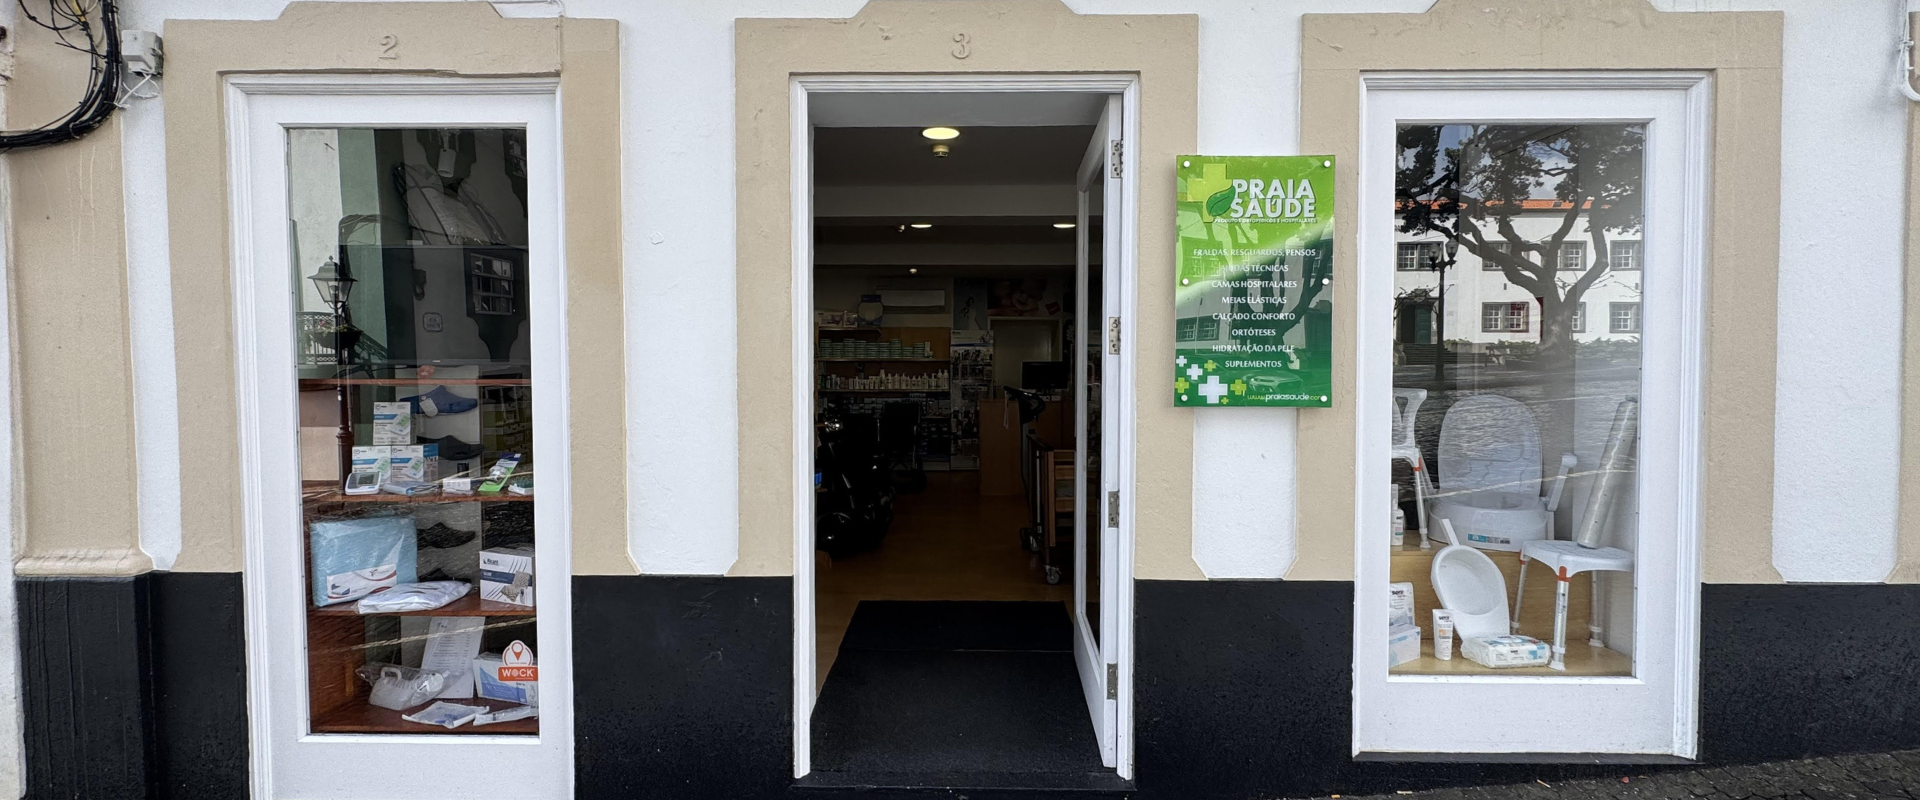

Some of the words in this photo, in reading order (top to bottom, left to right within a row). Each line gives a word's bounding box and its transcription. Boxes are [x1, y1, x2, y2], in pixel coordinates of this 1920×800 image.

[379, 33, 399, 60] 2
[951, 32, 971, 60] 3
[1232, 178, 1316, 200] PRAIA
[1230, 198, 1317, 218] SAÚDE
[1193, 248, 1229, 257] FRALDAS,
[1230, 248, 1285, 257] RESGUARDOS,
[1286, 248, 1316, 256] PENSOS
[1211, 280, 1240, 288] CAMAS
[1240, 280, 1297, 288] HOSPITALARES
[1221, 296, 1246, 304] MEIAS
[1247, 295, 1287, 304] ELÁSTICAS
[1212, 312, 1250, 322] CALÇADO
[1251, 312, 1295, 320] CONFORTO
[1231, 327, 1276, 336] ORTÓTESES
[1212, 344, 1263, 354] HIDRATAÇÃO
[1264, 344, 1277, 352] DA
[1277, 344, 1295, 352] PELE
[1225, 360, 1282, 368] SUPLEMENTOS
[502, 668, 534, 678] WOCK
